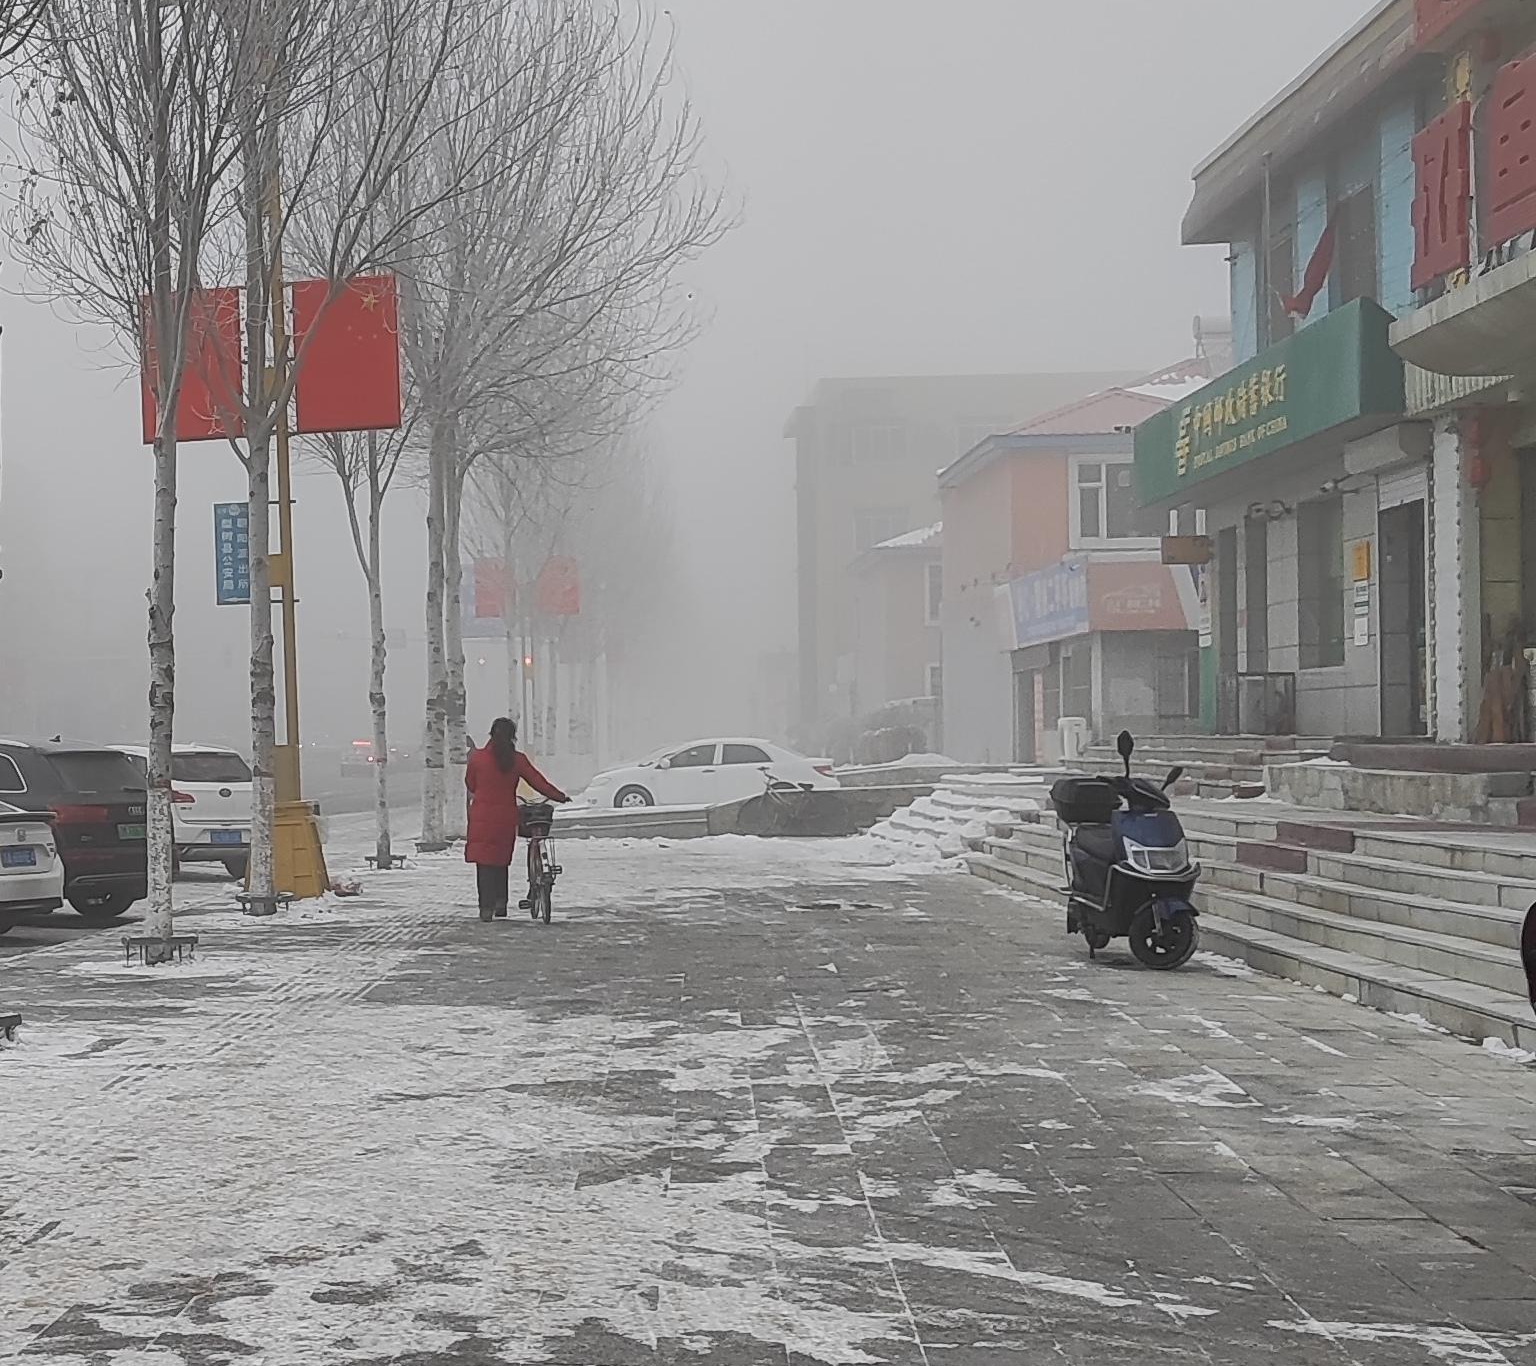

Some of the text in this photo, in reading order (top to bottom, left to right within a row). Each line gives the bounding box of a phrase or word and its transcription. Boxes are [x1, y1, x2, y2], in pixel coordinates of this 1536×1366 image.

[1193, 363, 1288, 450] 中国邮政储蓄银行
